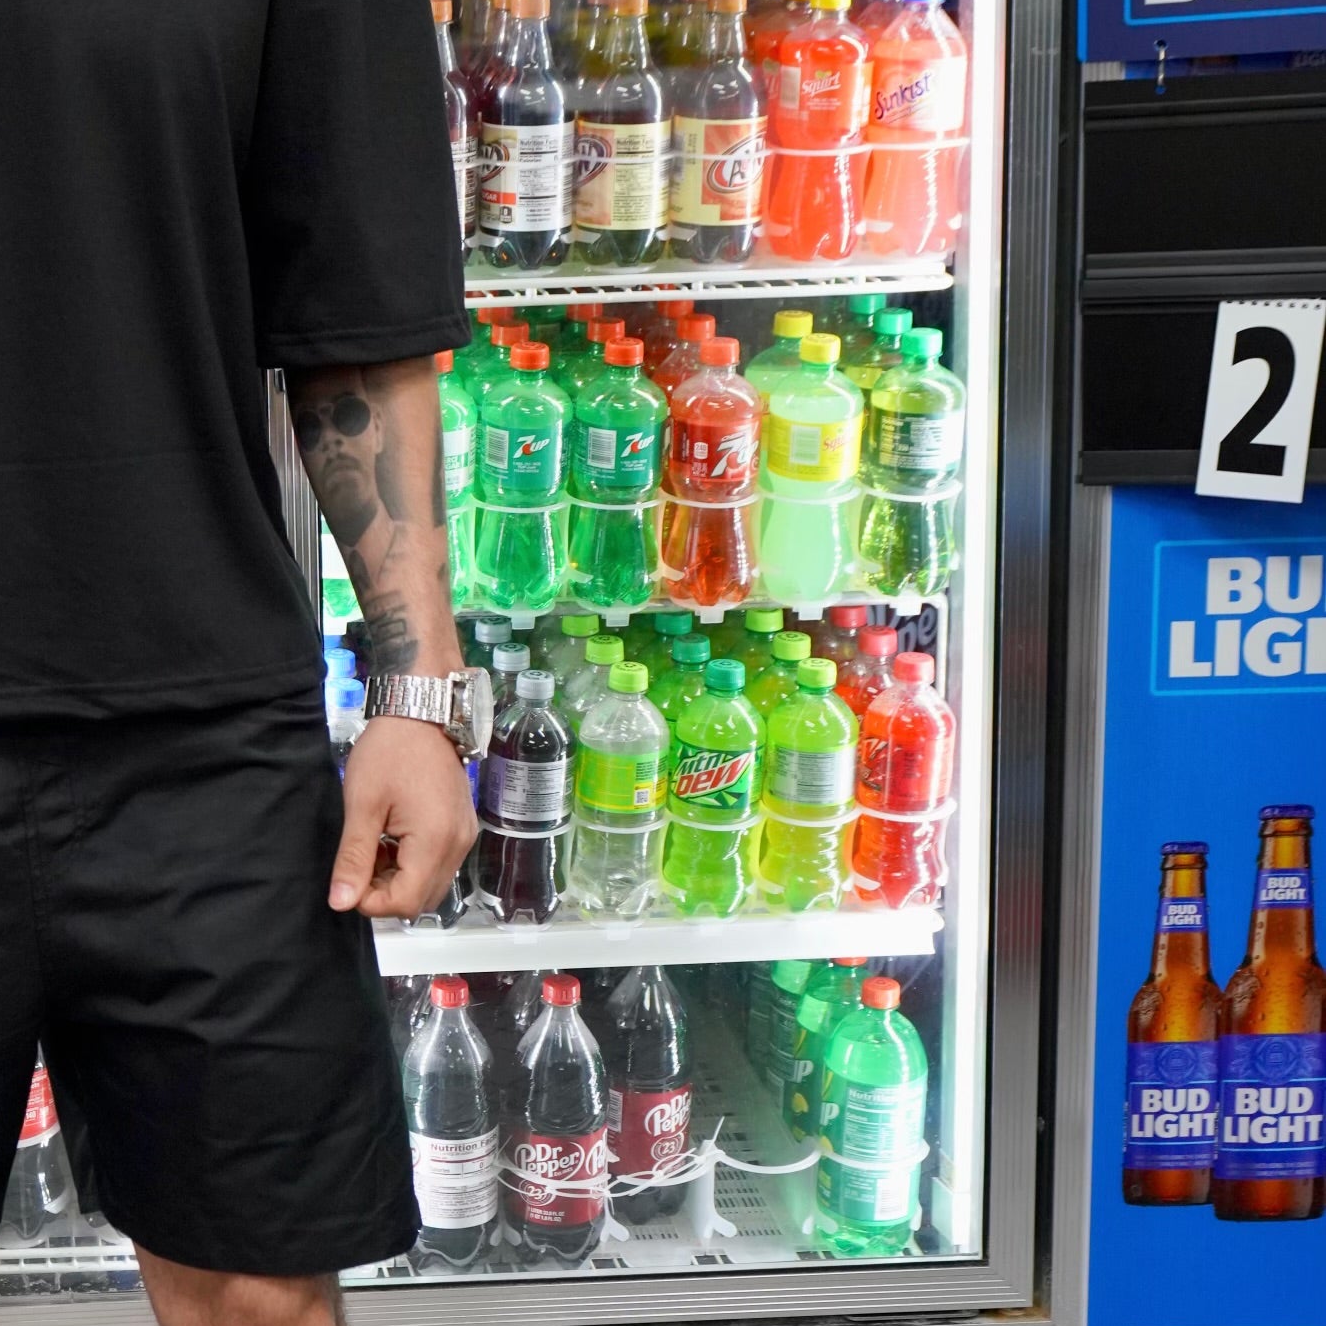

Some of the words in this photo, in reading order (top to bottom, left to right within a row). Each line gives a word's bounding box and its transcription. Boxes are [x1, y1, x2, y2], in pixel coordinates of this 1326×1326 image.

[802, 75, 843, 96] Squirt
[874, 75, 932, 120] Sunkist
[1216, 325, 1296, 476] 2
[513, 434, 550, 459] 7UP
[620, 432, 655, 458] 7UP
[1206, 555, 1326, 615] BU
[1169, 617, 1326, 678] LIG
[1260, 888, 1306, 902] LIGHT
[1267, 876, 1301, 890] BUD
[1161, 913, 1202, 926] LIGHT
[1167, 904, 1198, 915] BUD
[1141, 1088, 1210, 1113] BUD
[1234, 1087, 1315, 1115] BUD
[1131, 1112, 1217, 1139] LIGHT
[1224, 1114, 1324, 1145] LIGHT
[431, 1141, 477, 1152] Nutrition
[536, 1143, 562, 1164] Dr
[515, 1144, 580, 1180] Pepper
